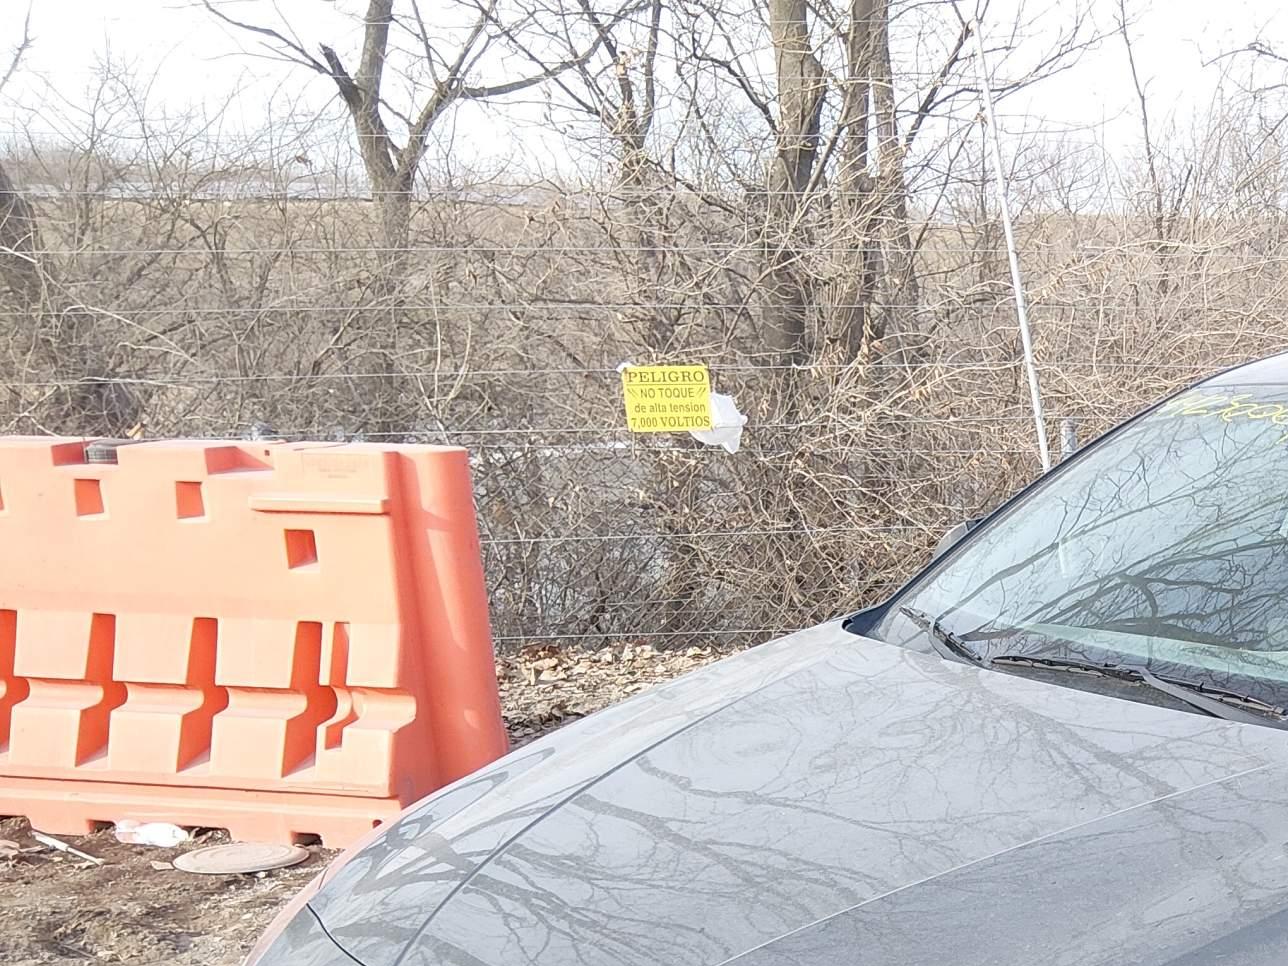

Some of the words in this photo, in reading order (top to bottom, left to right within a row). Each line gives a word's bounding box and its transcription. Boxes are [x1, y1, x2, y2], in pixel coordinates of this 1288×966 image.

[628, 371, 704, 382] PELIGRO
[640, 388, 655, 398] NO
[658, 387, 694, 398] TOQUE
[634, 403, 646, 413] de
[649, 402, 667, 413] alta
[669, 402, 706, 413] tension
[631, 417, 658, 428] 7,000
[660, 415, 710, 427] VOLTIOS
